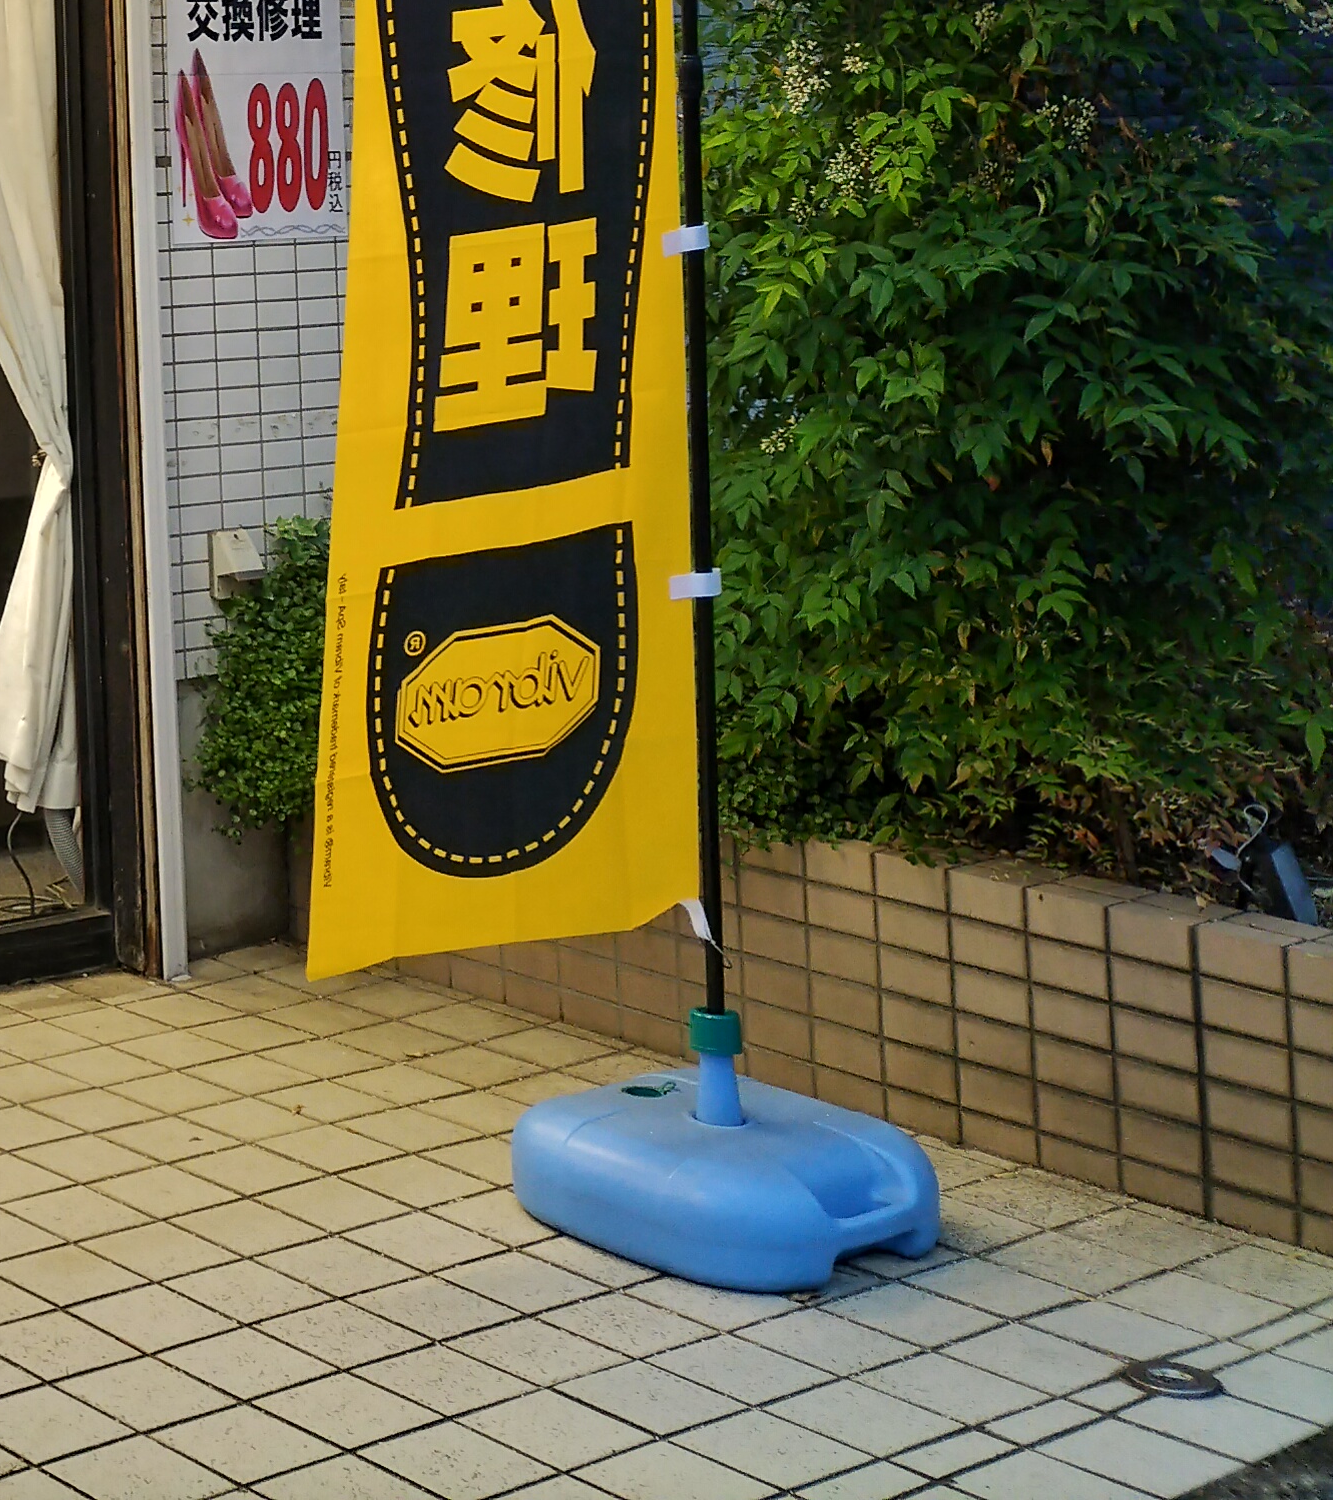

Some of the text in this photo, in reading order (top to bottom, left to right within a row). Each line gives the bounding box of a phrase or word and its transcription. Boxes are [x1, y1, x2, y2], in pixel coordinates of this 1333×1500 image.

[247, 77, 344, 213] 880 円税込
